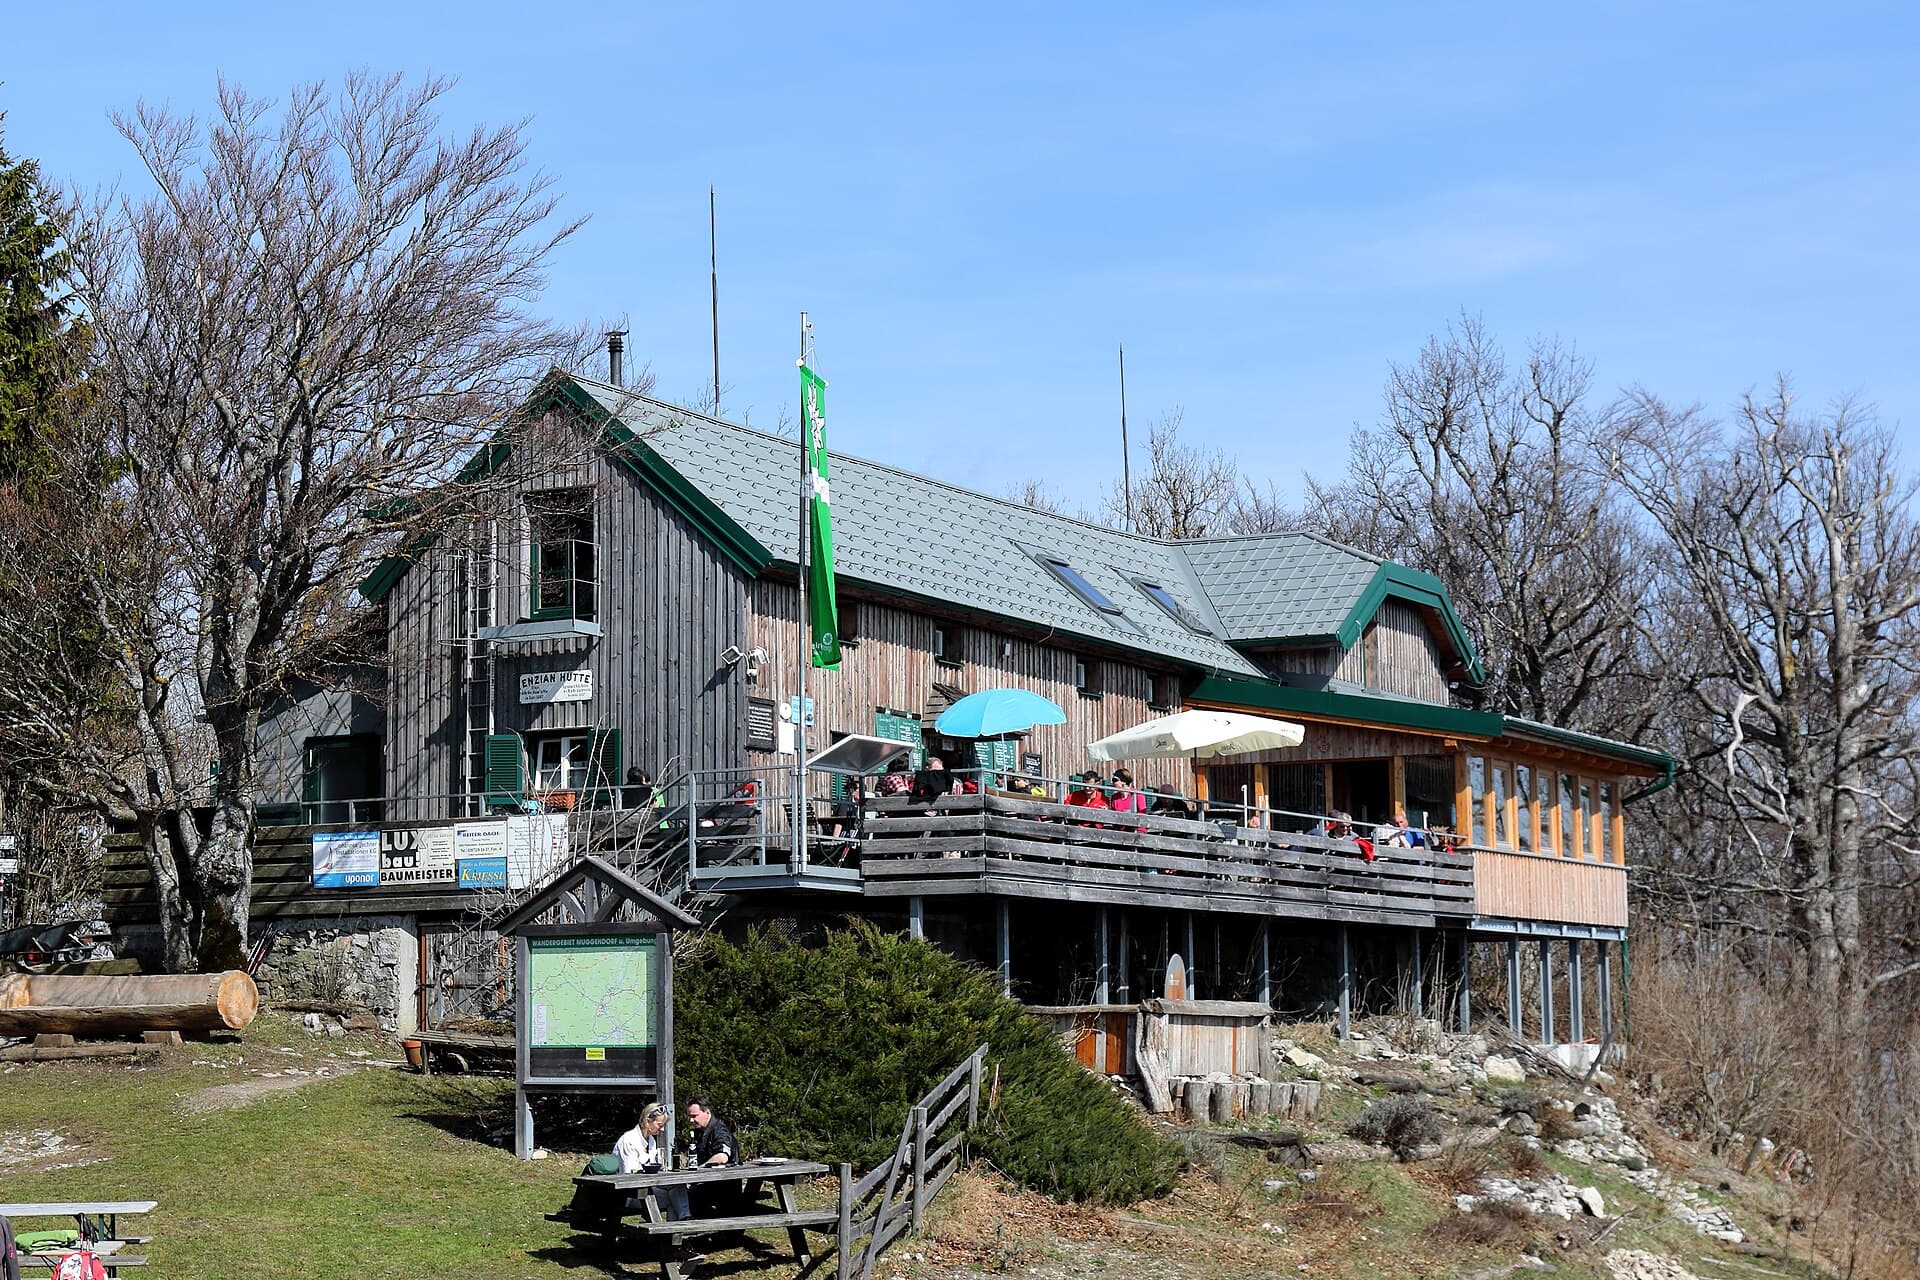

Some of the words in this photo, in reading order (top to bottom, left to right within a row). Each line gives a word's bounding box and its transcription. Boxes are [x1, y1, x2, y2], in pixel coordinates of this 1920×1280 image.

[522, 674, 555, 688] ENZIAN
[381, 830, 427, 851] LUX
[381, 851, 420, 868] bau!
[345, 874, 374, 884] uponor
[381, 869, 454, 882] BAUMEISTER
[576, 938, 617, 946] MUGGENDORF
